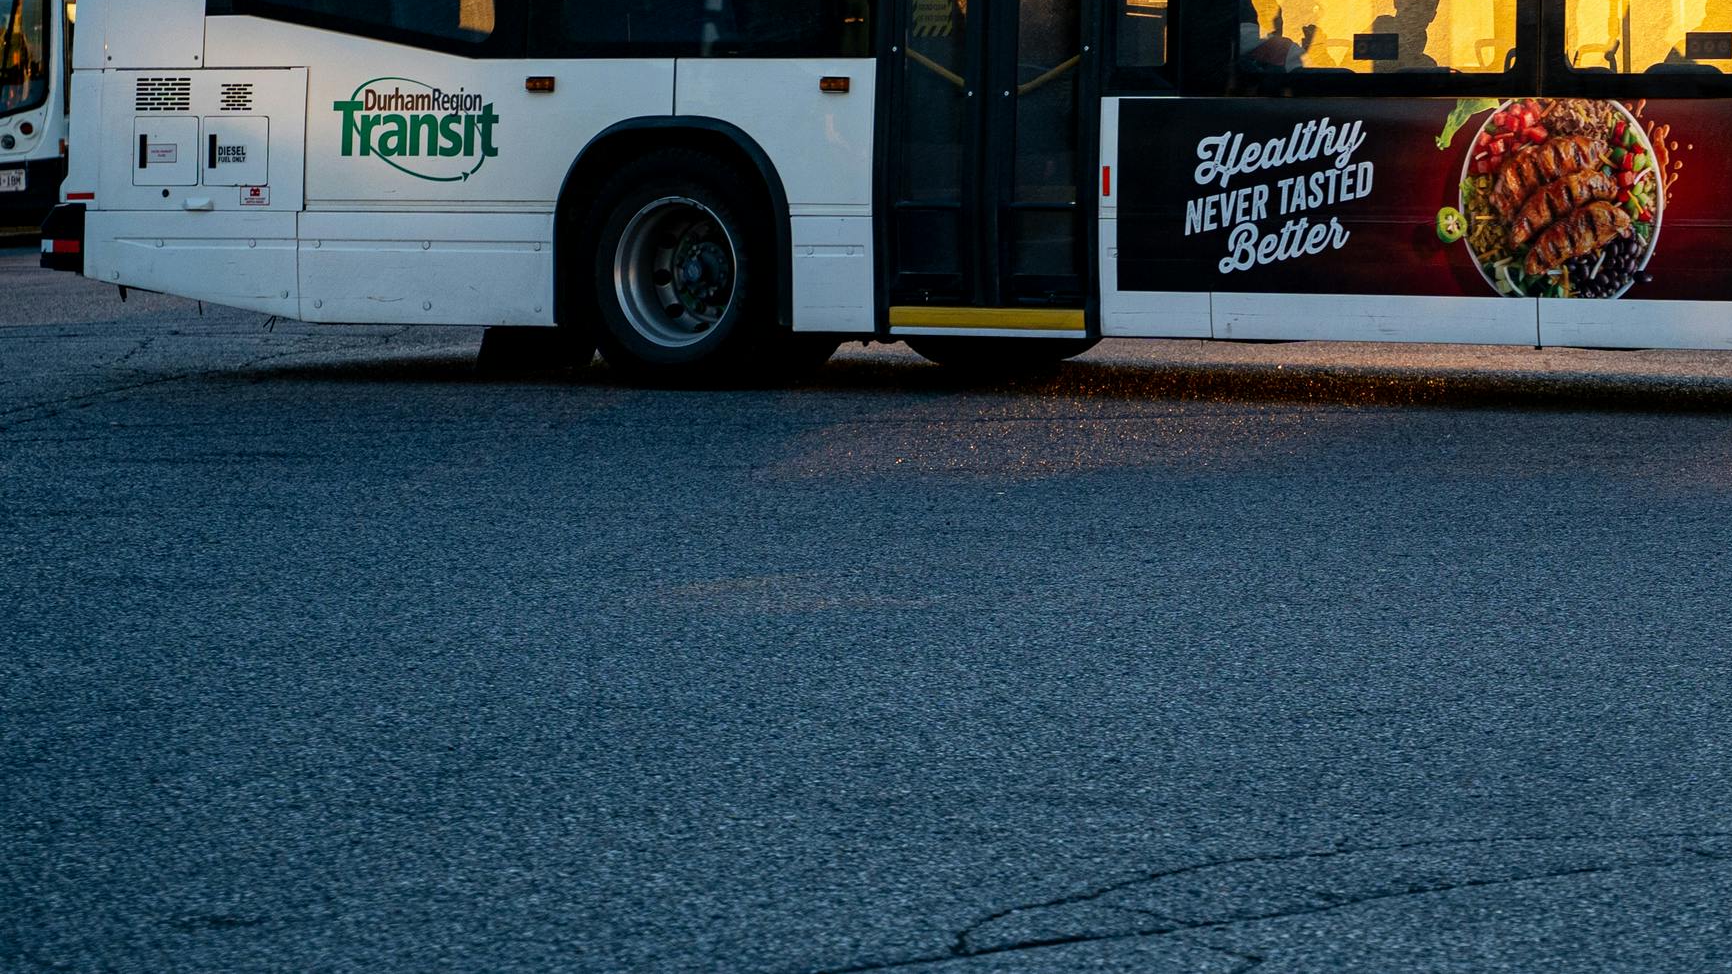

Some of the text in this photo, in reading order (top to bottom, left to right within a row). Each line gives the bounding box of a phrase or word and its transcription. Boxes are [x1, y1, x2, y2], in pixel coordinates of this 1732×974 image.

[333, 101, 499, 157] Transit
[364, 87, 483, 116] DurhamRegion
[218, 146, 246, 156] DIESEL
[1194, 117, 1367, 188] Healthy
[1184, 161, 1374, 236] NEVER TASTED
[1218, 216, 1350, 274] Better
